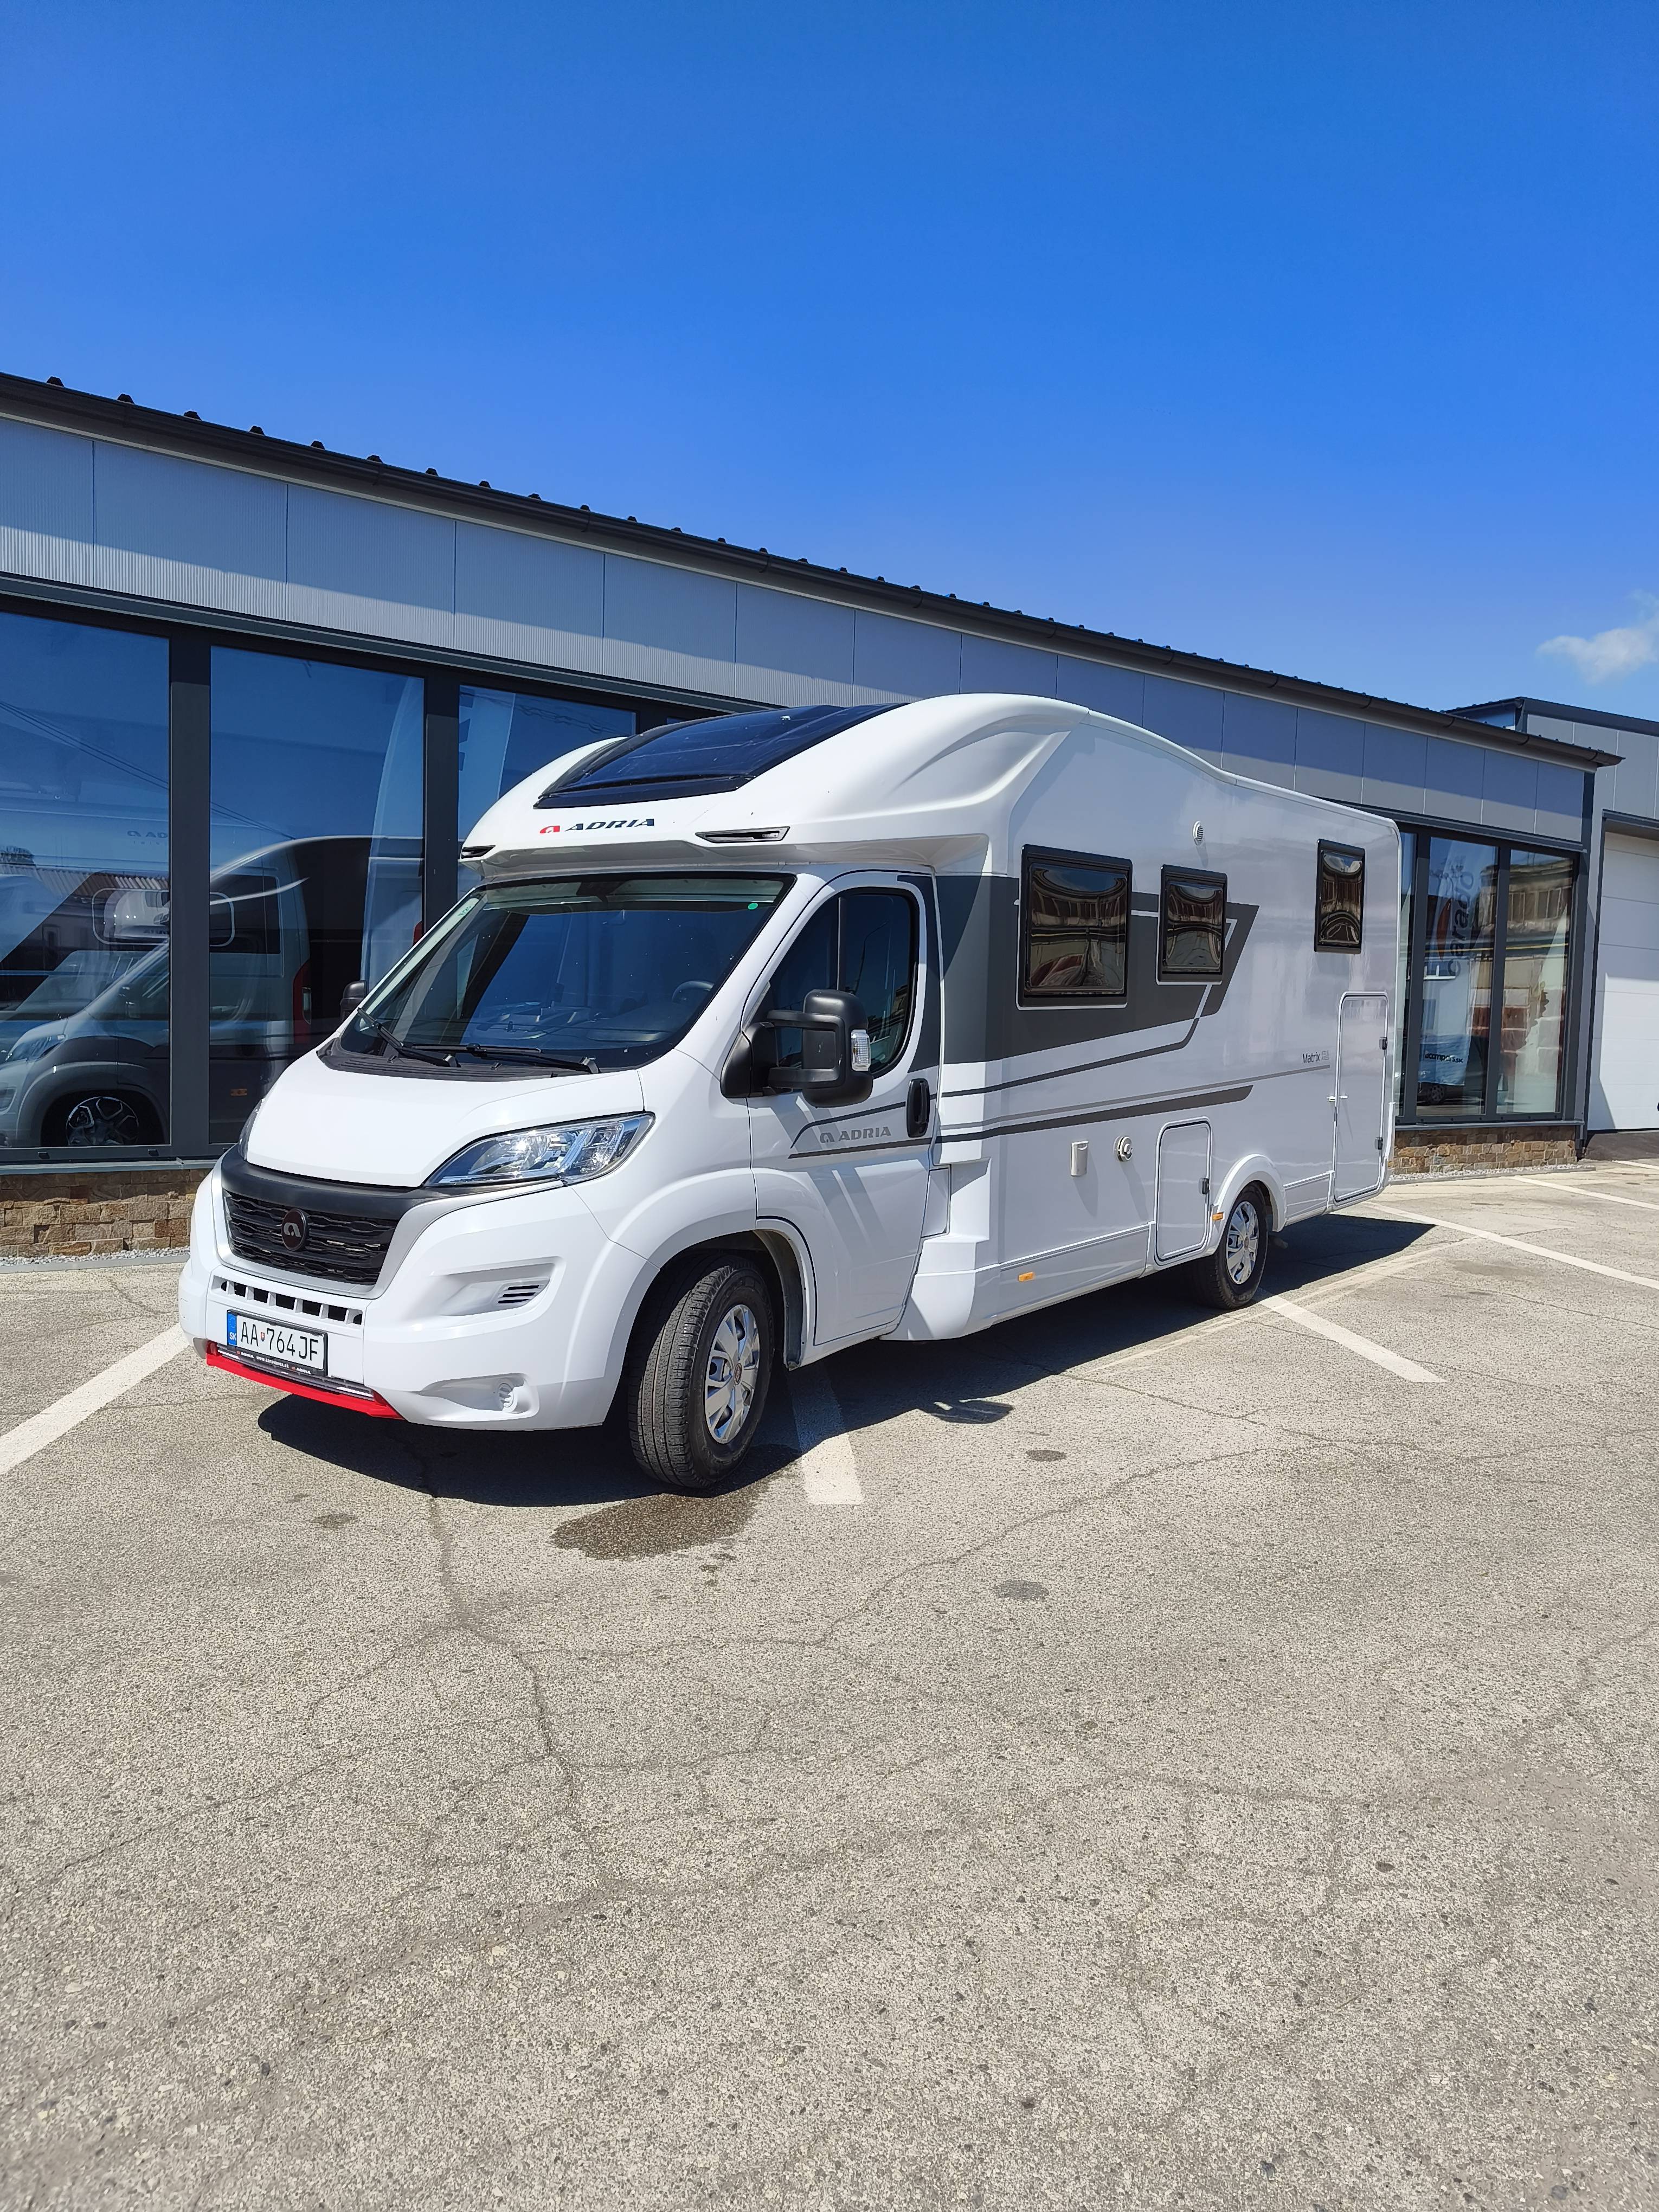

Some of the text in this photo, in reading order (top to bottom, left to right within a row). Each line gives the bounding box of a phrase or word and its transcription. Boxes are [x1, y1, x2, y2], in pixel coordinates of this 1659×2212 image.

[565, 818, 654, 832] ADRIA
[1448, 871, 1474, 977] carado
[1302, 1051, 1320, 1064] Matrix
[838, 1126, 891, 1141] ADRIA
[229, 1332, 236, 1341] SK
